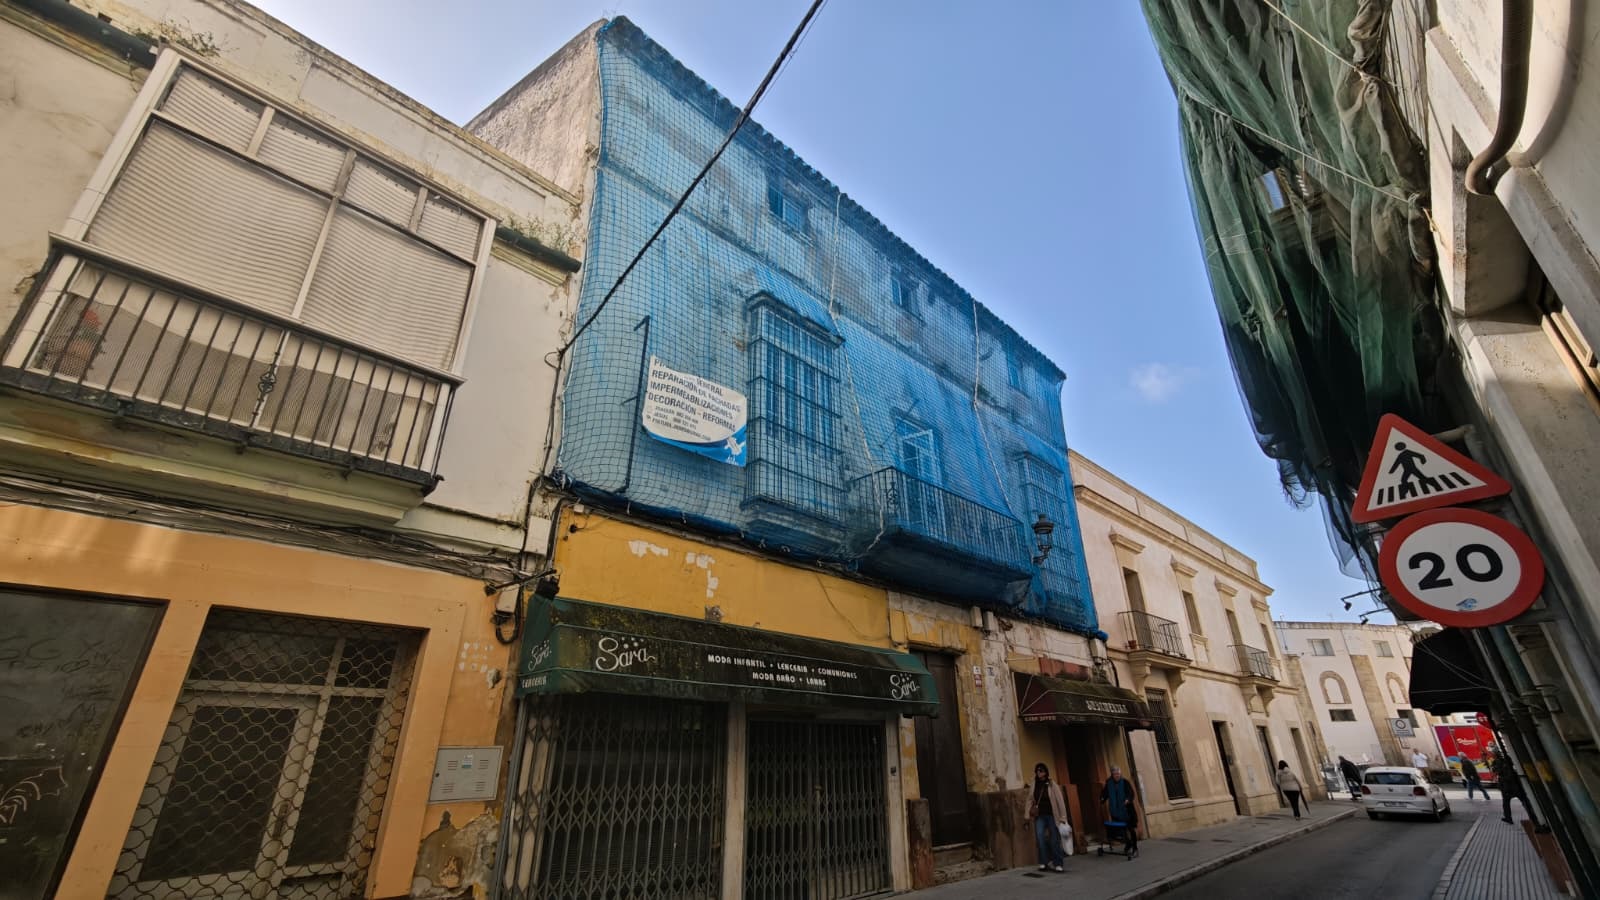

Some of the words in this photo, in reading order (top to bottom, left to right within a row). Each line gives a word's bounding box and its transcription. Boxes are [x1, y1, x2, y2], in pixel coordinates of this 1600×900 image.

[702, 412, 736, 432] REFORMAS
[1408, 543, 1503, 590] 20
[595, 637, 656, 672] Sara
[707, 654, 731, 665] MODA
[734, 658, 766, 668] INFANTIL
[818, 667, 857, 679] COMUNIONES
[752, 672, 774, 681] MODA
[776, 673, 795, 683] BAÑO
[806, 677, 826, 686] LANAS
[889, 674, 921, 700] Sara
